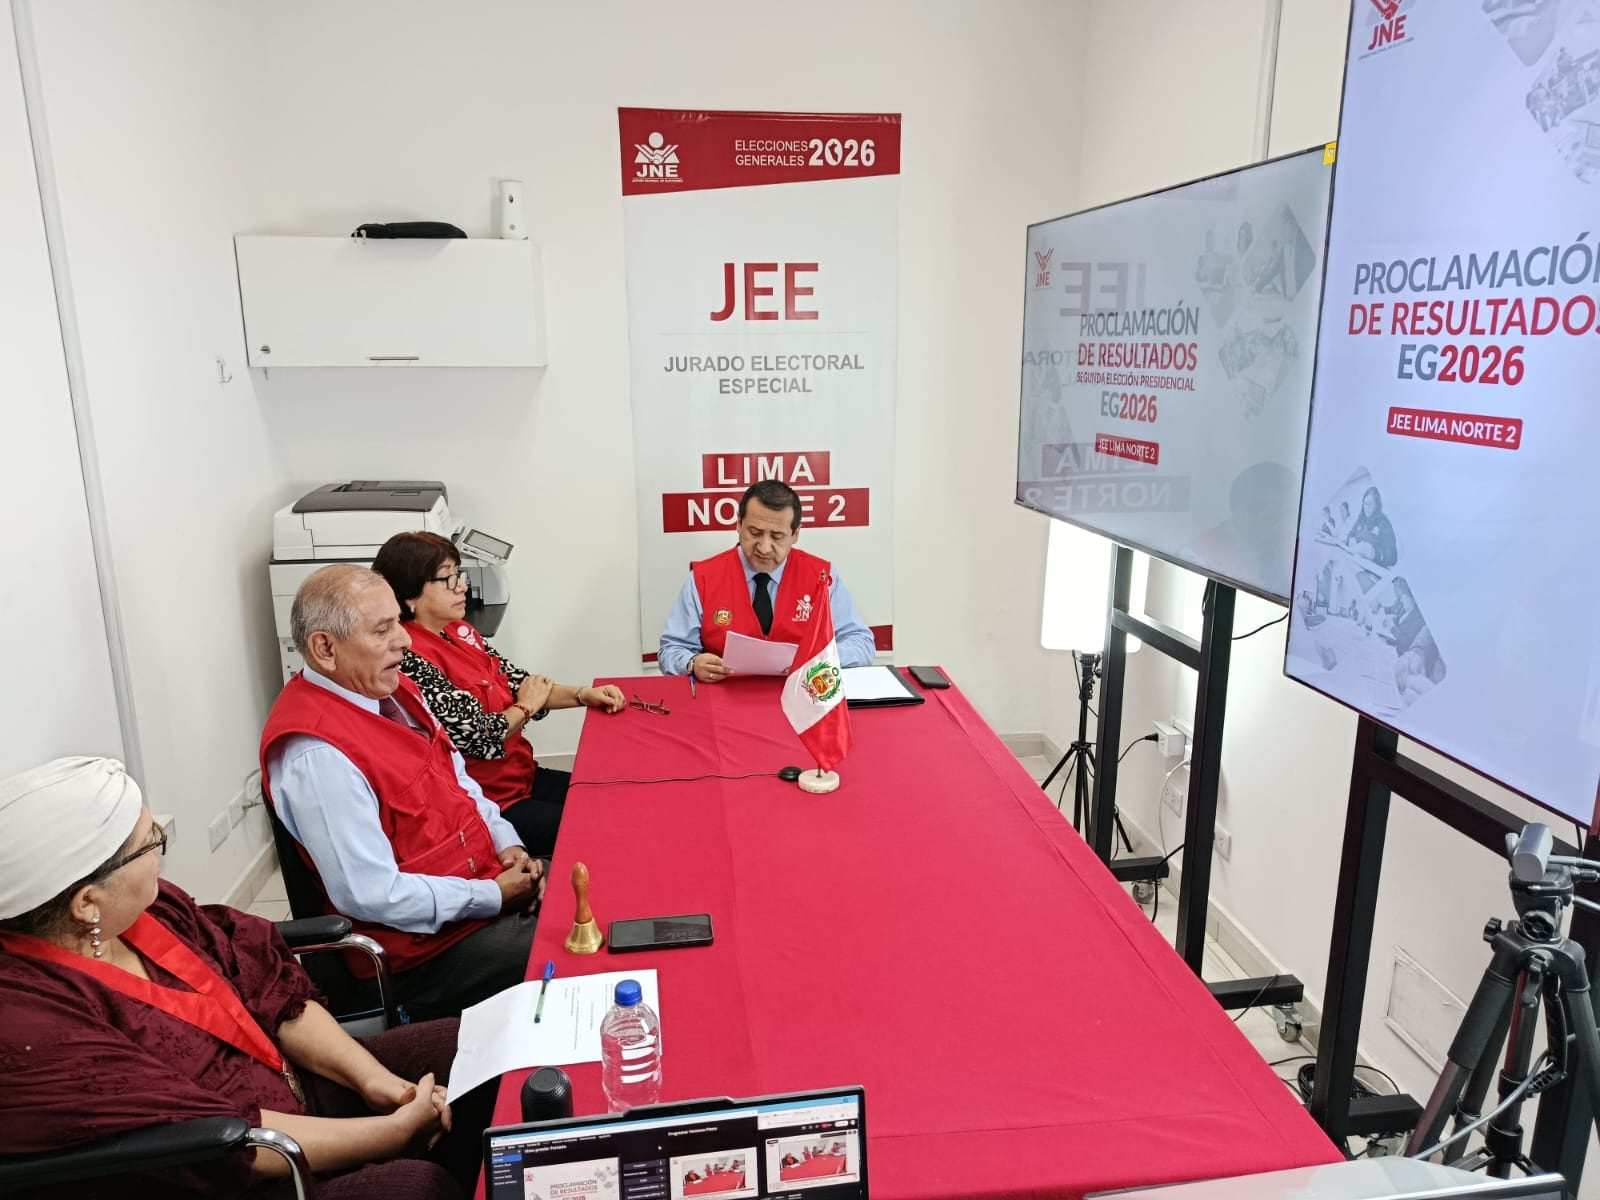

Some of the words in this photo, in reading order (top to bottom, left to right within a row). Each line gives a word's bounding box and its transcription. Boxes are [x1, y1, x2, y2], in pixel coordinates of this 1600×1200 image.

[1368, 14, 1407, 50] JNE
[735, 139, 808, 152] ELECCIONES
[808, 138, 876, 167] 2026
[636, 164, 679, 178] JNE
[735, 154, 805, 167] GENERALES
[710, 262, 819, 322] JEE
[1035, 271, 1050, 288] JNE
[1079, 300, 1199, 337] PROCLAMACIÓN
[1348, 302, 1385, 336] DE
[1390, 294, 1600, 336] RESULTADO
[663, 355, 745, 372] JURADO
[750, 354, 865, 371] ELECTORAL
[1077, 342, 1095, 366] DE
[1098, 342, 1197, 371] RESULTADOS
[1397, 343, 1525, 386] EG2026
[719, 377, 812, 394] ESPECIAL
[1076, 371, 1106, 385] SEGUNDA
[1106, 371, 1140, 387] ELECCIÓN
[1140, 375, 1195, 391] PRESIDENCIAL
[1101, 390, 1157, 423] EG2026
[1390, 413, 1413, 430] JEE
[1414, 415, 1448, 435] LIMA
[1450, 419, 1503, 441] NORTE
[1505, 425, 1517, 444] 2
[1098, 438, 1109, 450] JEE
[1109, 440, 1126, 453] LIMA
[1126, 442, 1149, 459] NORTE
[1149, 447, 1155, 460] 2
[717, 455, 816, 485] LIMA
[687, 495, 815, 527] NOE
[827, 494, 846, 522] 2
[795, 610, 810, 619] JN
